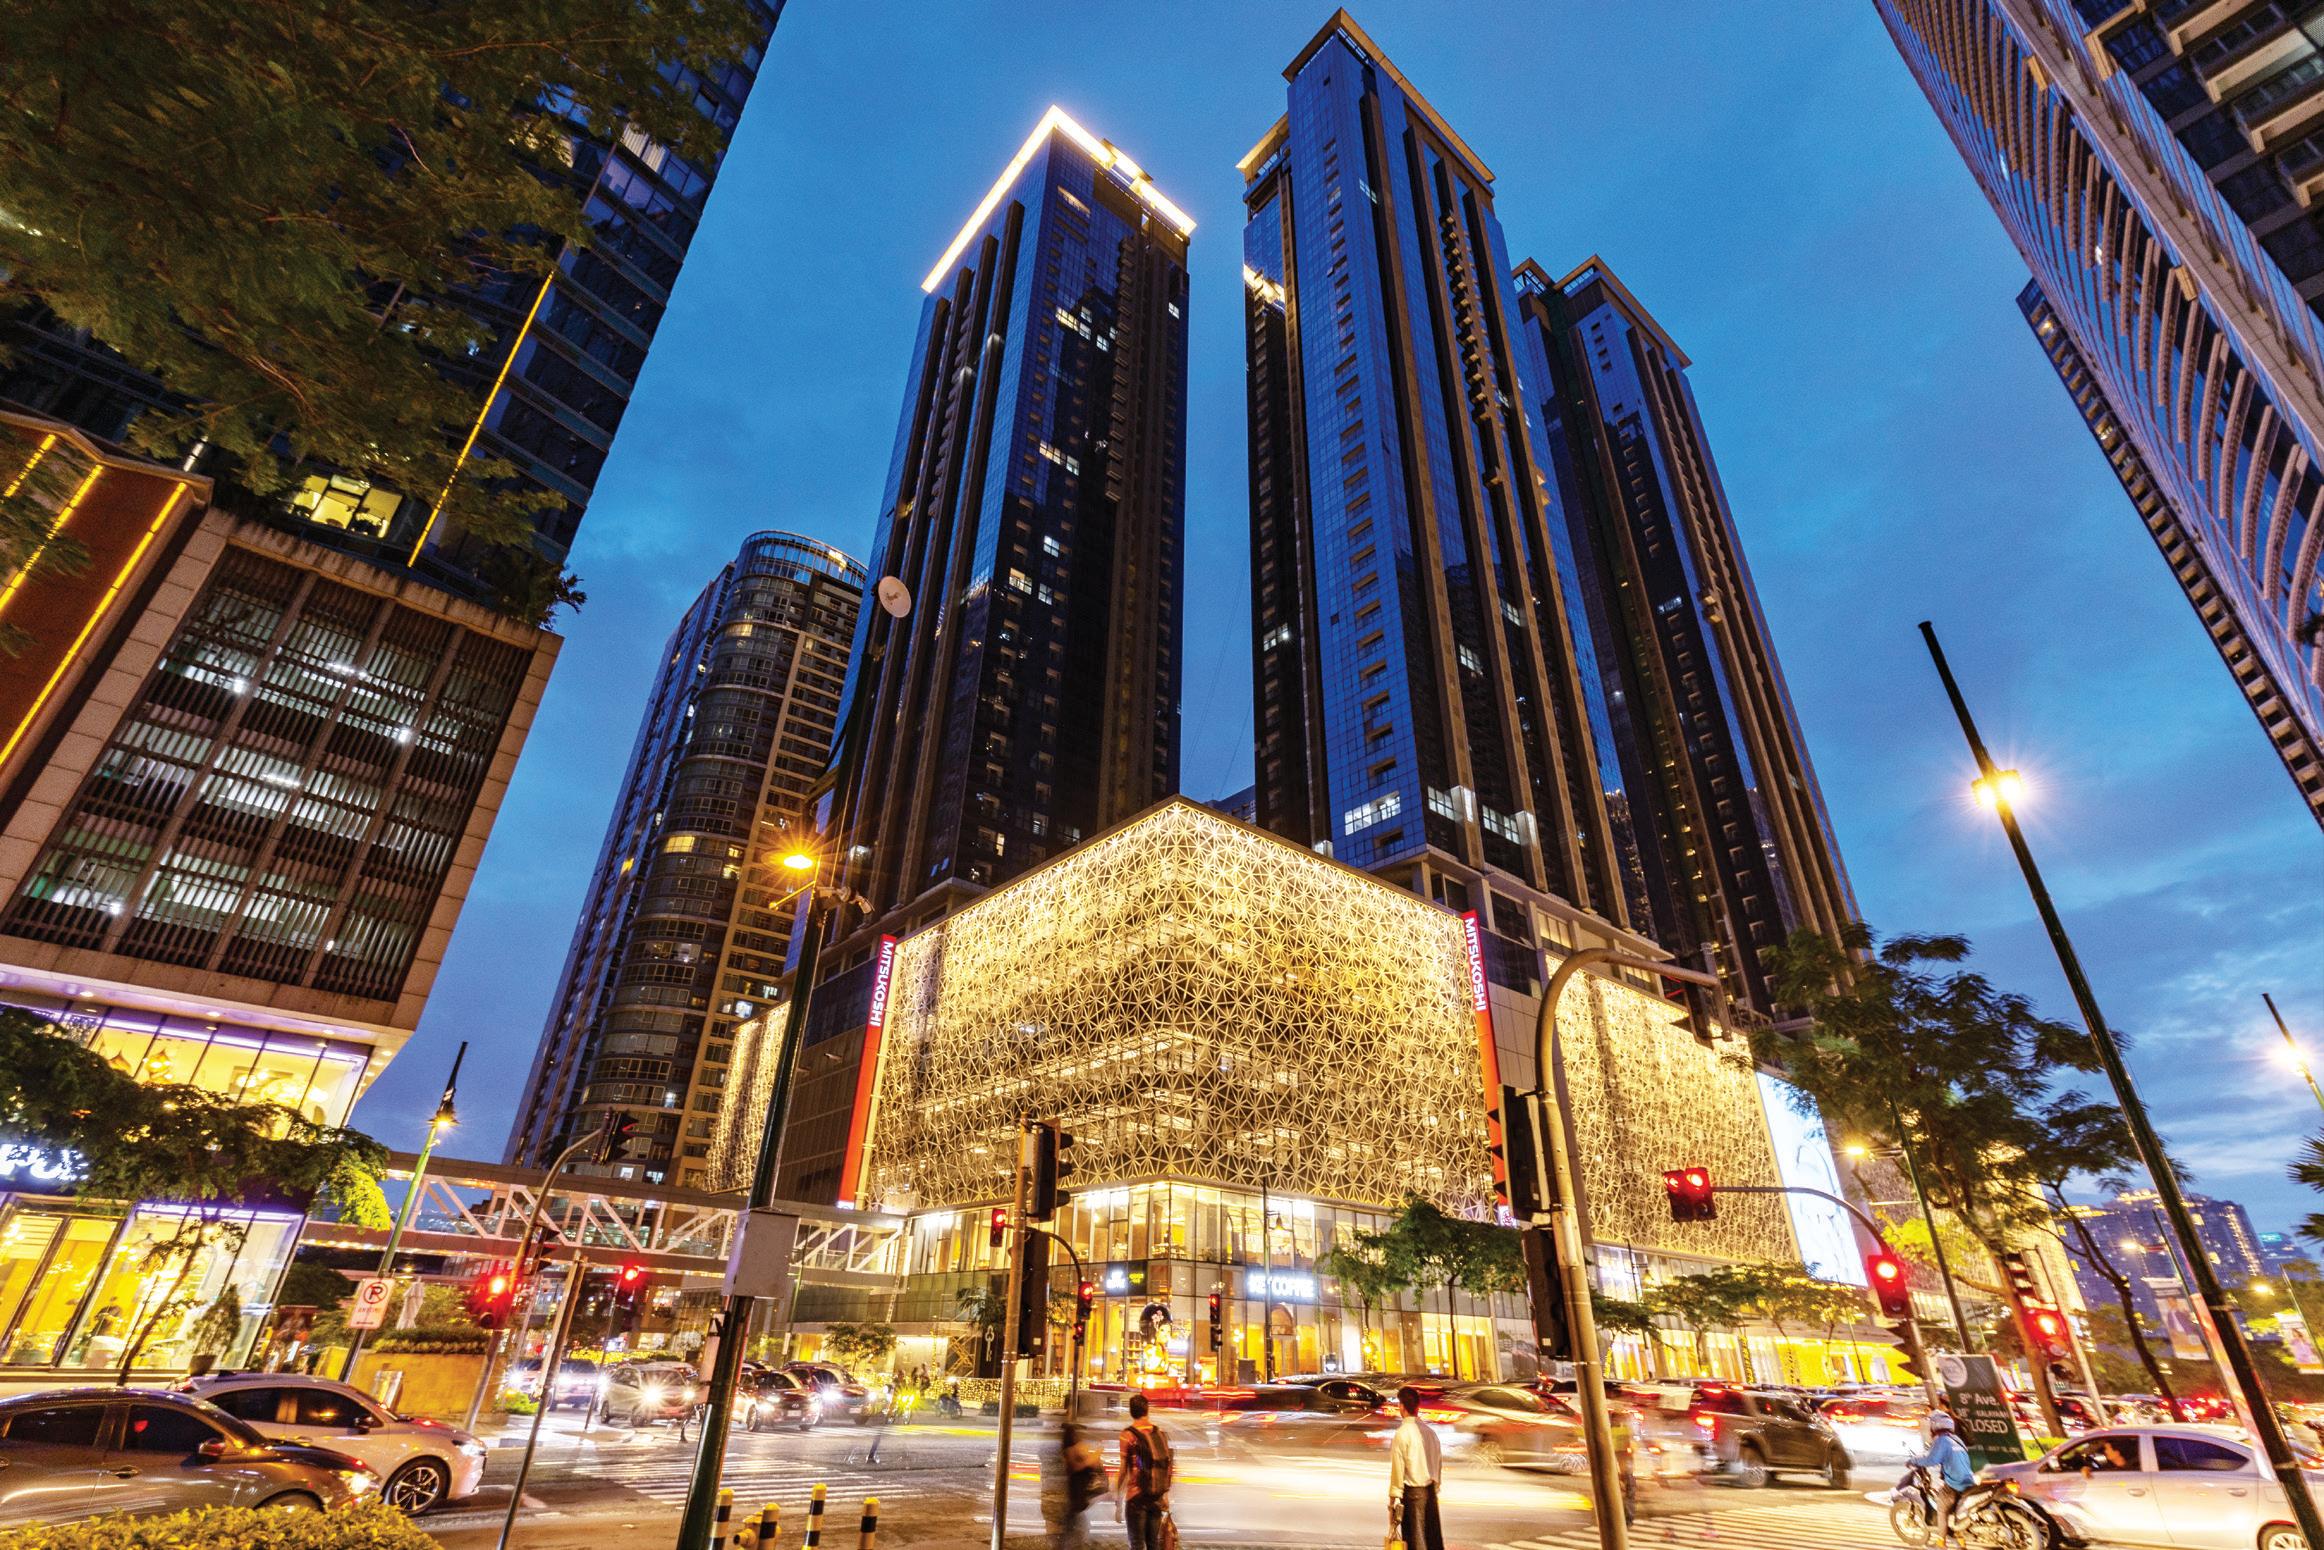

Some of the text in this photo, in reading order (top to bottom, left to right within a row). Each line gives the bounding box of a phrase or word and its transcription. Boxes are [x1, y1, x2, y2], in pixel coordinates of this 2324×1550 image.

[869, 941, 895, 1028] MITSUKOSHI
[1465, 917, 1487, 1012] MITSUKOSHI
[1974, 1393, 2000, 1406] Ave.
